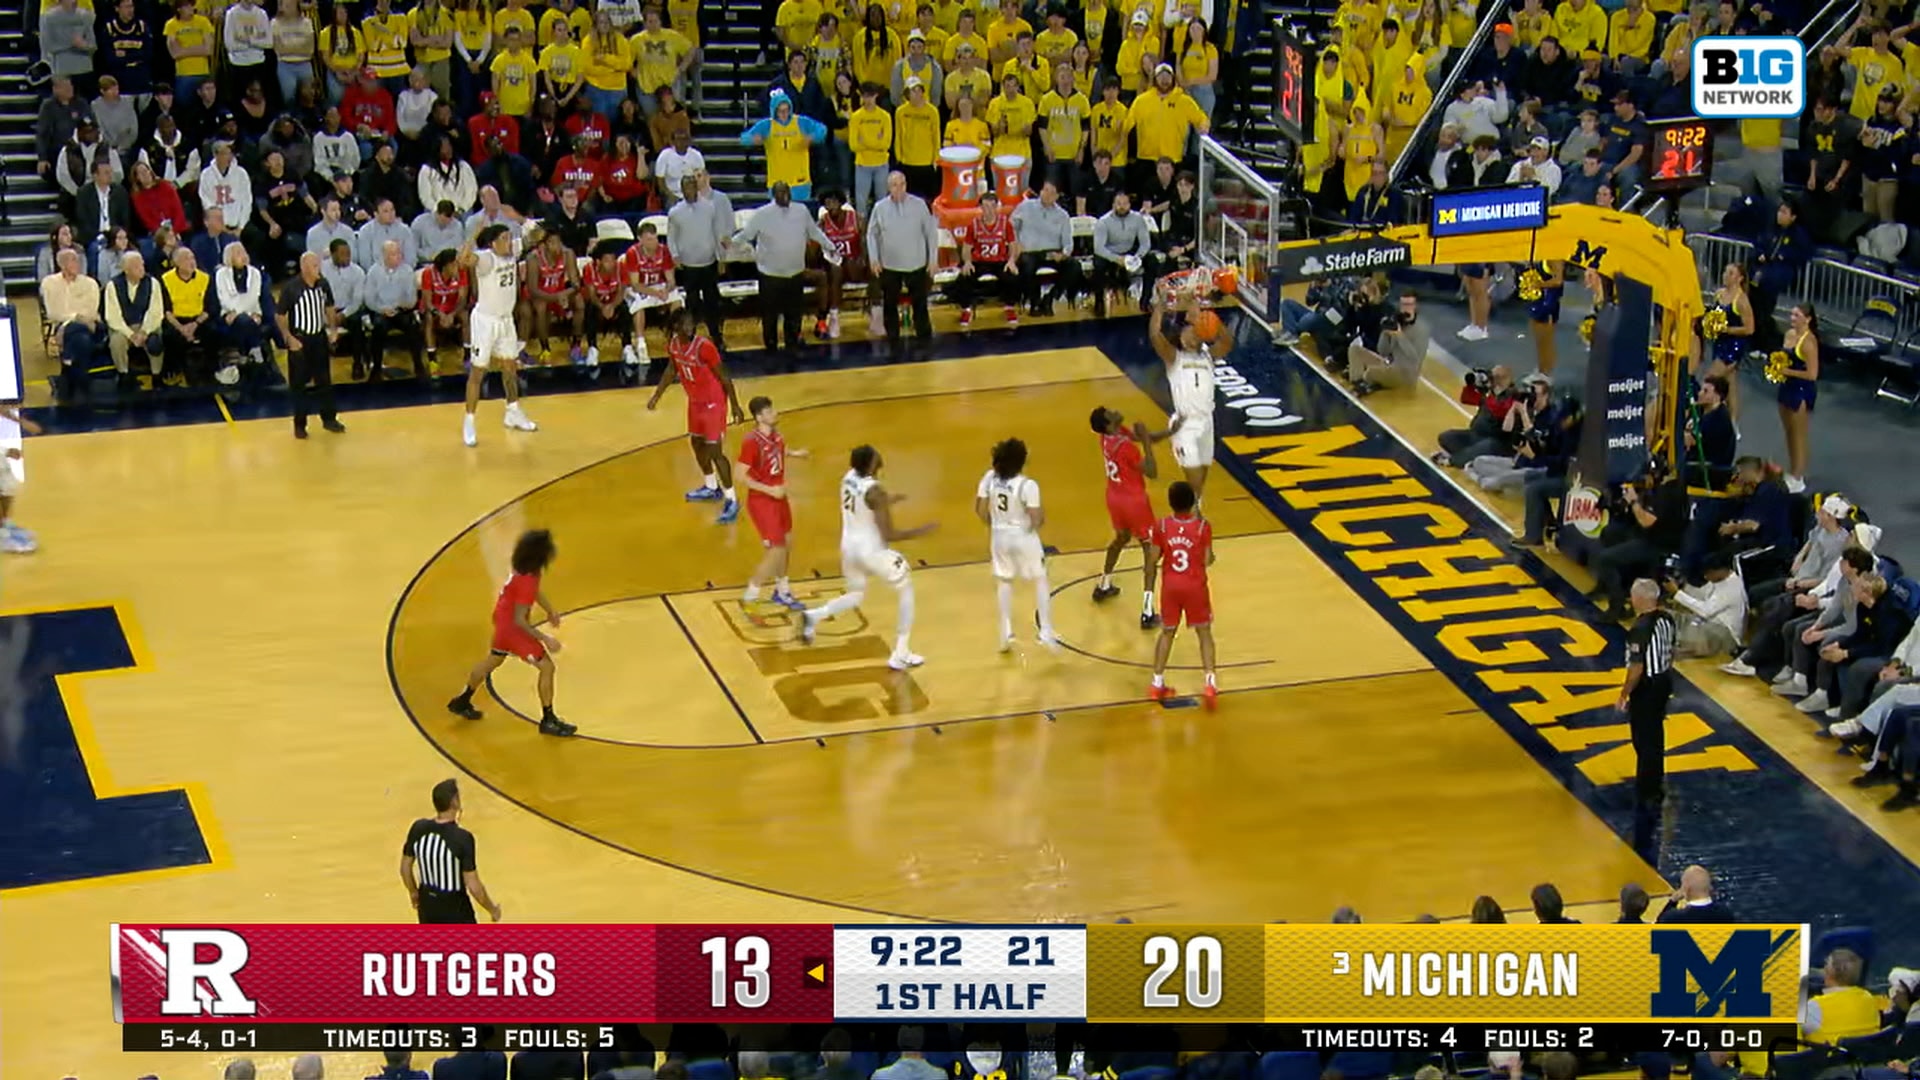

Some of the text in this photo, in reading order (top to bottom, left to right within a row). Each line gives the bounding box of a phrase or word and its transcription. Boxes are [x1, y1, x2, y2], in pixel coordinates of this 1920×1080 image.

[1665, 127, 1706, 147] 9:22
[1661, 150, 1696, 177] 21
[958, 169, 974, 186] G
[1006, 174, 1018, 187] G
[1439, 201, 1541, 224] M MICHIGAN MEDICINE
[981, 244, 998, 256] 24
[1570, 239, 1607, 269] M
[500, 272, 514, 287] 23
[1194, 372, 1199, 388] 1
[1608, 378, 1645, 394] meijer
[1607, 404, 1643, 420] meijer
[1608, 433, 1645, 449] meijer
[997, 493, 1008, 512] 3
[1564, 493, 1602, 522] LIBMA
[1172, 549, 1189, 573] 3
[1221, 424, 1759, 787] MICHIGAN
